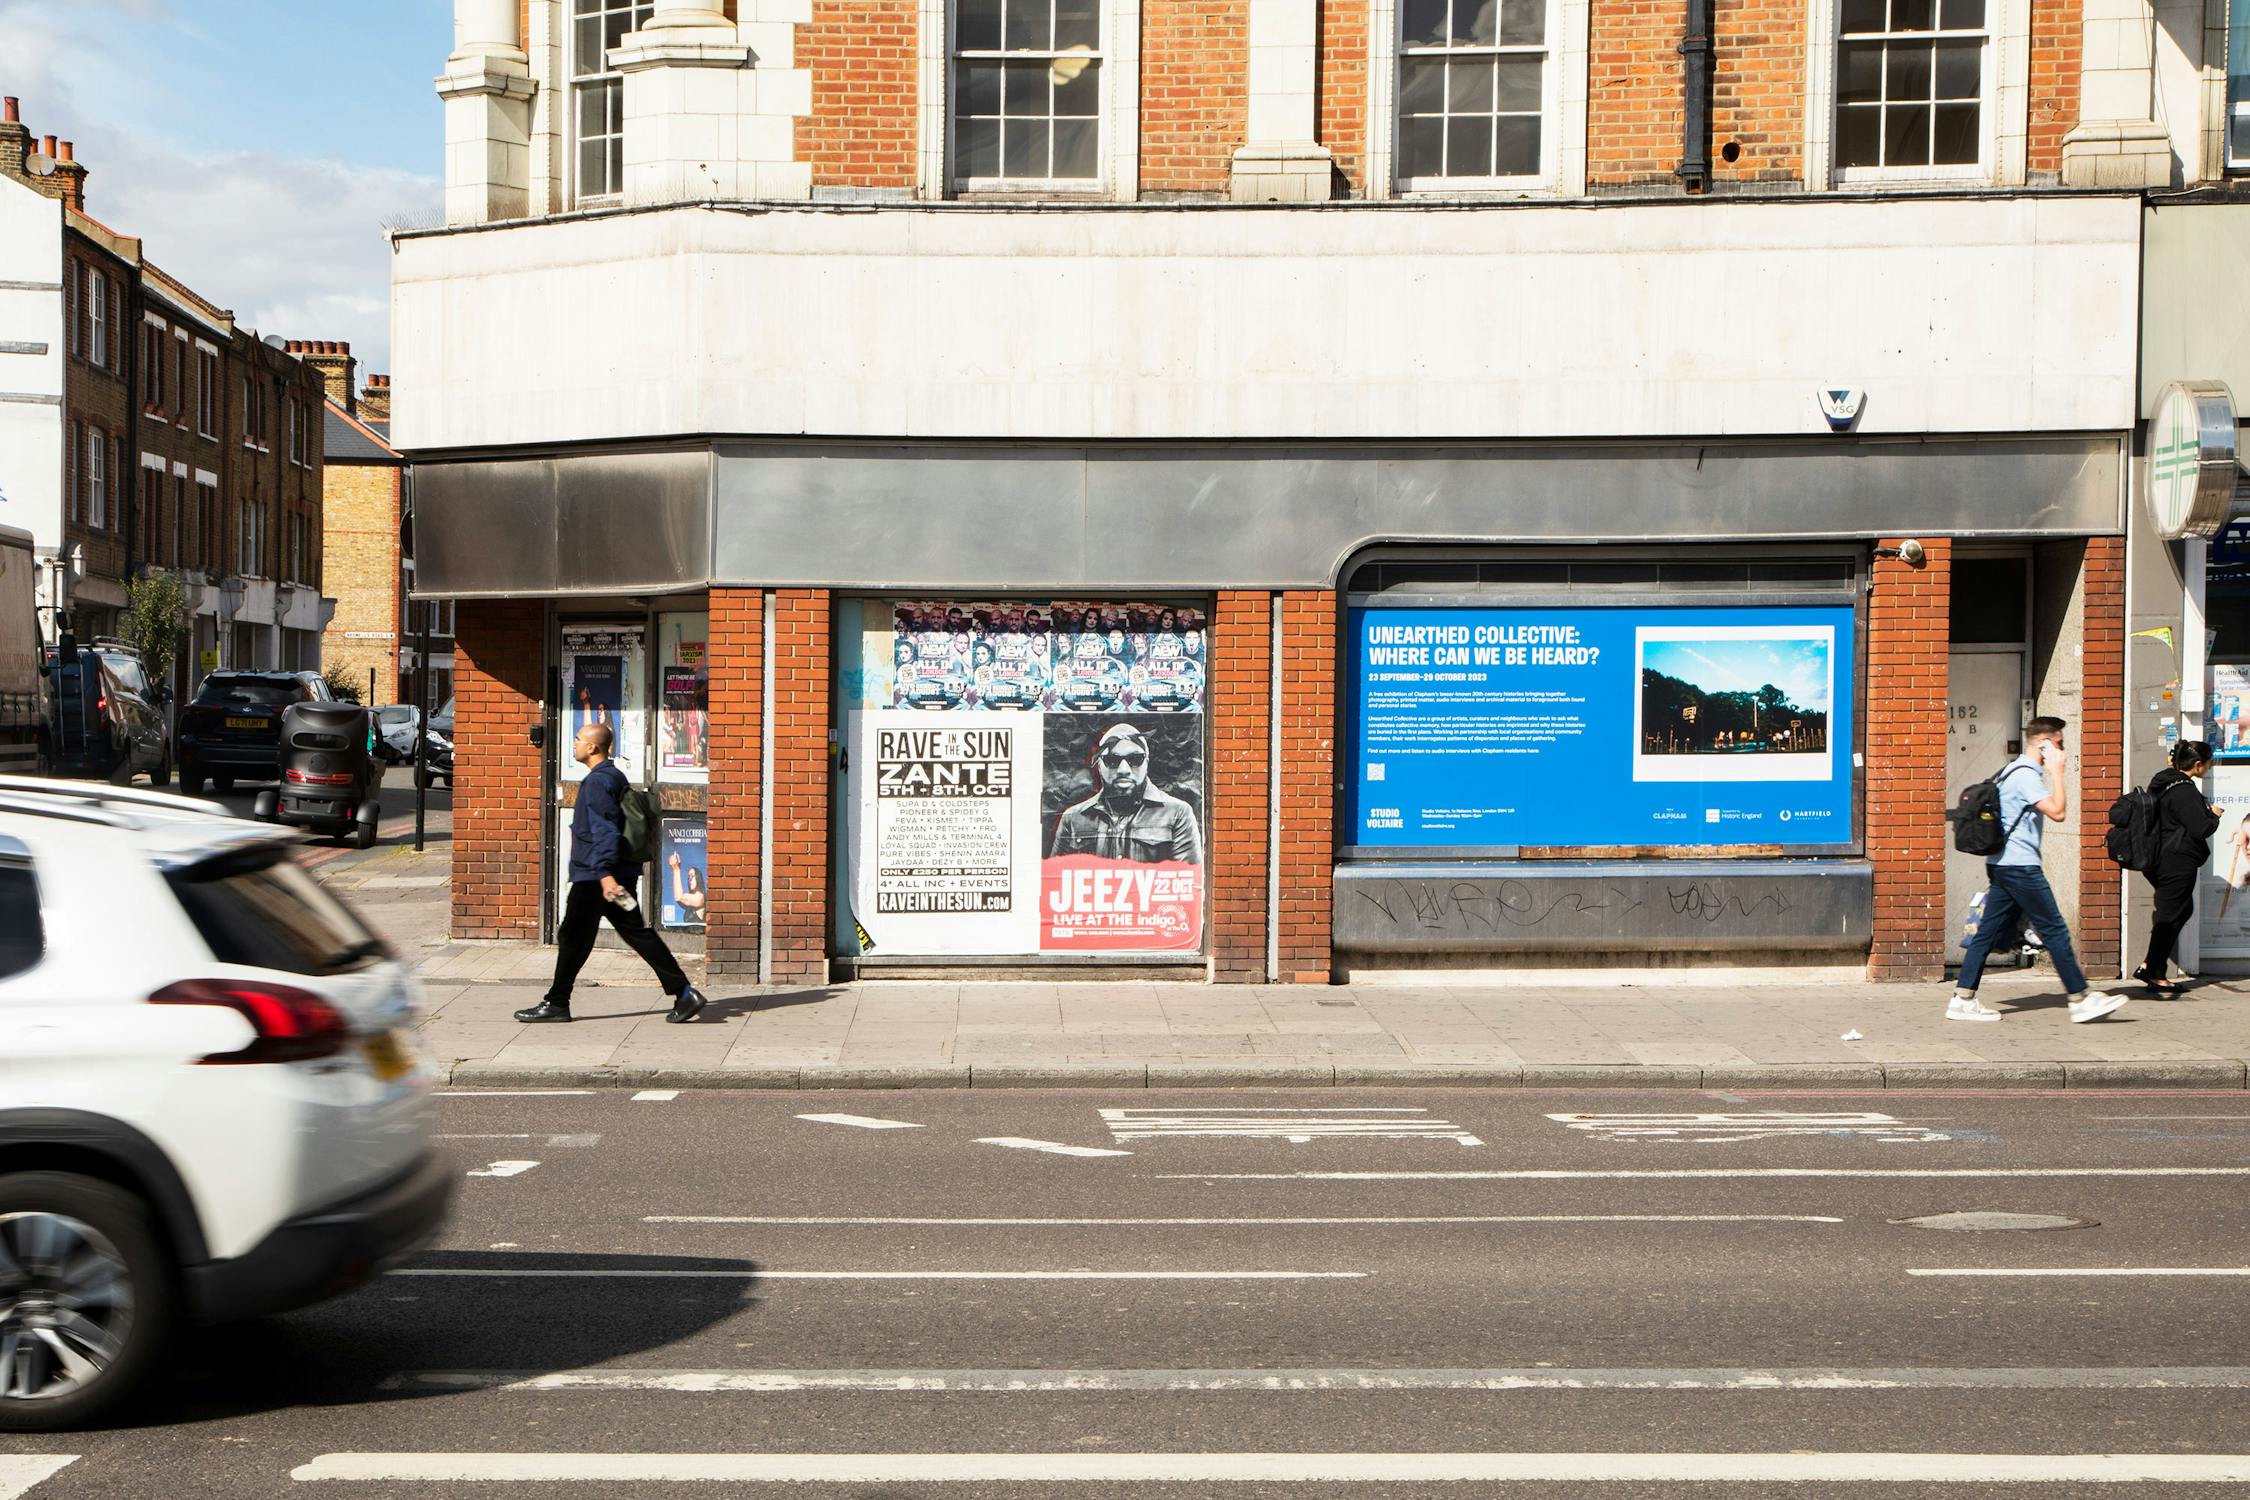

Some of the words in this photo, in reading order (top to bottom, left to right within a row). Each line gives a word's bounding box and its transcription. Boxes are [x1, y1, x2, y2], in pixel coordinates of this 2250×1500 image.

[1369, 626, 1469, 644] UNEARTHED
[1475, 626, 1580, 644] COLLECTIVE:
[920, 644, 948, 655] AEW
[998, 646, 1026, 657] AEW
[1076, 645, 1104, 656] AEW
[1152, 646, 1180, 657] AEW
[1369, 648, 1429, 665] WHERE
[1434, 648, 1469, 665] CAN
[1474, 648, 1500, 665] WE
[1505, 648, 1526, 665] BE
[1532, 647, 1599, 664] HEARD?
[917, 660, 939, 669] ALL
[941, 660, 953, 669] IN
[994, 662, 1016, 671] ALL
[1019, 662, 1030, 671] IN
[1072, 661, 1095, 670] ALL
[1097, 661, 1108, 670] IN
[1148, 662, 1170, 670] ALL
[1172, 662, 1184, 670] IN
[1949, 725, 1956, 734] A
[1969, 725, 1976, 734] B
[948, 734, 957, 743] IN
[880, 732, 942, 758] RAVE
[945, 745, 960, 755] THE
[964, 732, 1008, 758] SUN
[880, 763, 1010, 784] ZANTE
[880, 785, 914, 795] 5TH
[932, 785, 967, 795] 8TH
[973, 784, 1009, 795] OCT
[1370, 808, 1400, 817] STUDIO
[1366, 819, 1403, 828] VOLTAIRE
[1050, 870, 1156, 912] JEEZY
[1154, 879, 1170, 894] 22
[1173, 879, 1194, 894] OCT
[880, 893, 1009, 910] RAVEINTHESUN.COM
[1053, 915, 1083, 925] LIVE
[1086, 914, 1106, 925] AT
[1108, 914, 1132, 925] THE
[1138, 914, 1176, 928] indigo
